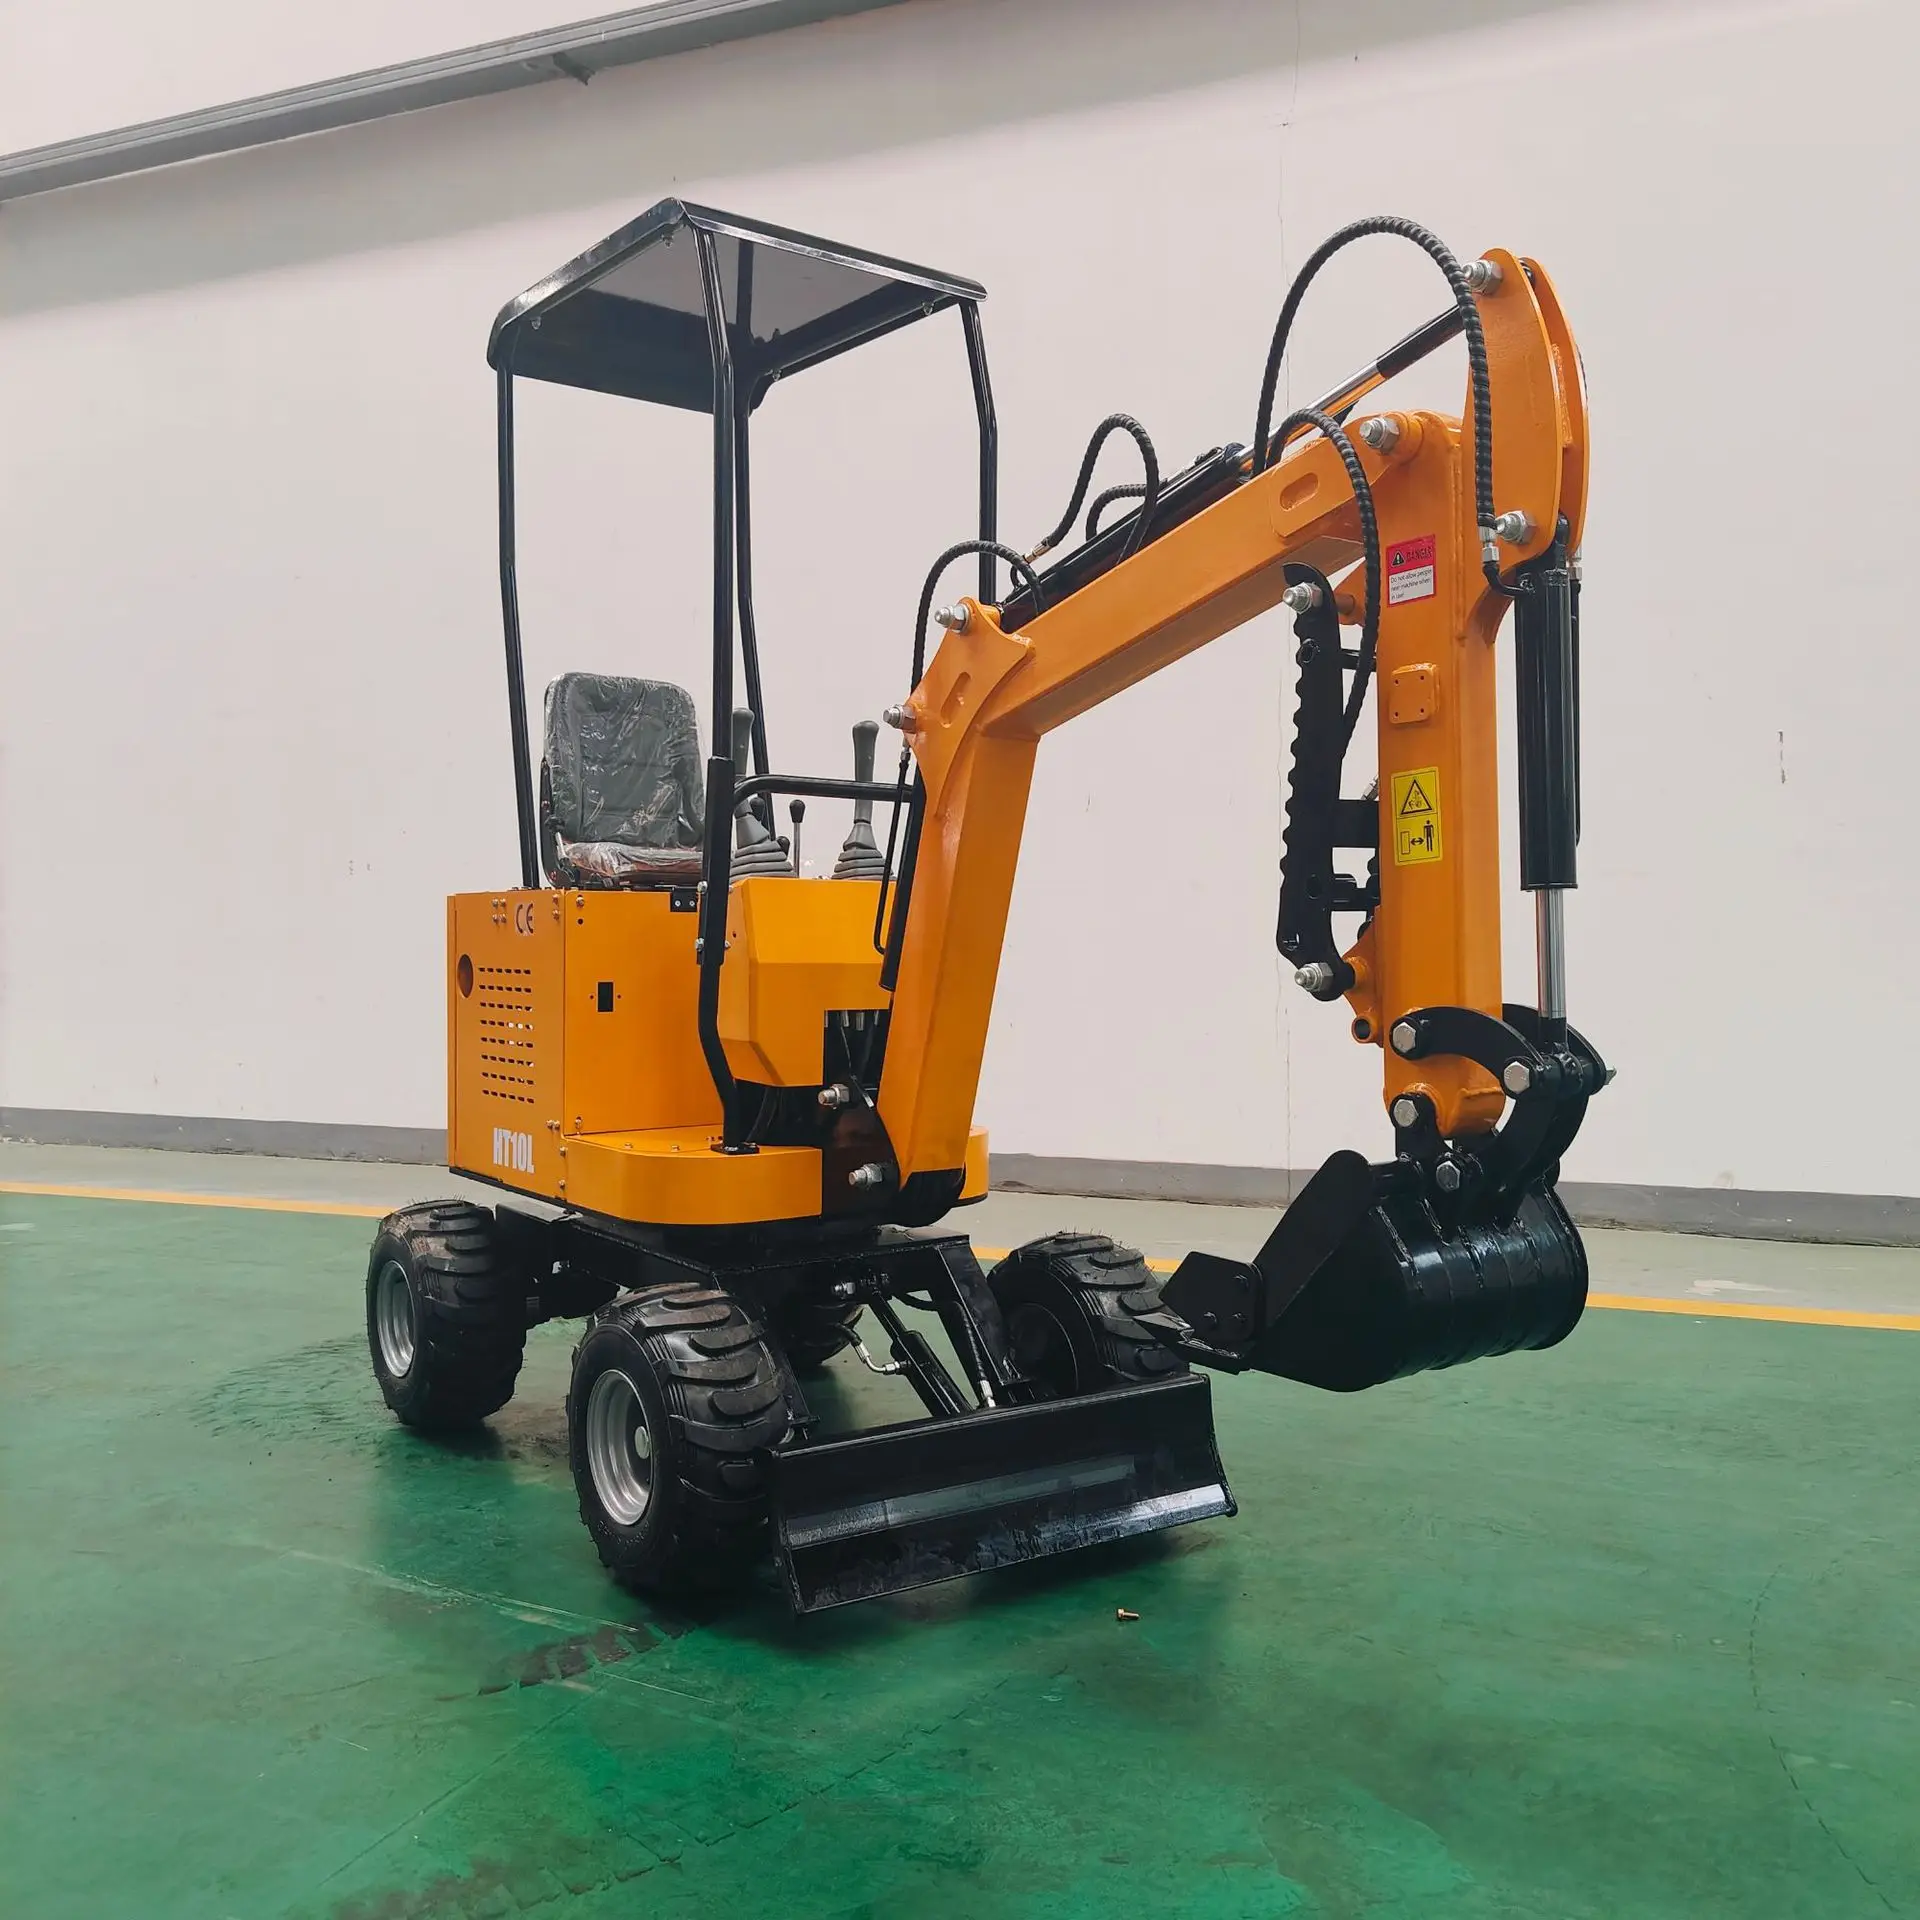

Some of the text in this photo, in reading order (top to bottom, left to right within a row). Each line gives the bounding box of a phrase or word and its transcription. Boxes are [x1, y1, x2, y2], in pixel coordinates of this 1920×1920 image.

[1406, 546, 1432, 562] DANGER
[1405, 571, 1417, 580] allow
[516, 903, 534, 934] CE
[493, 1127, 535, 1173] HT10L
